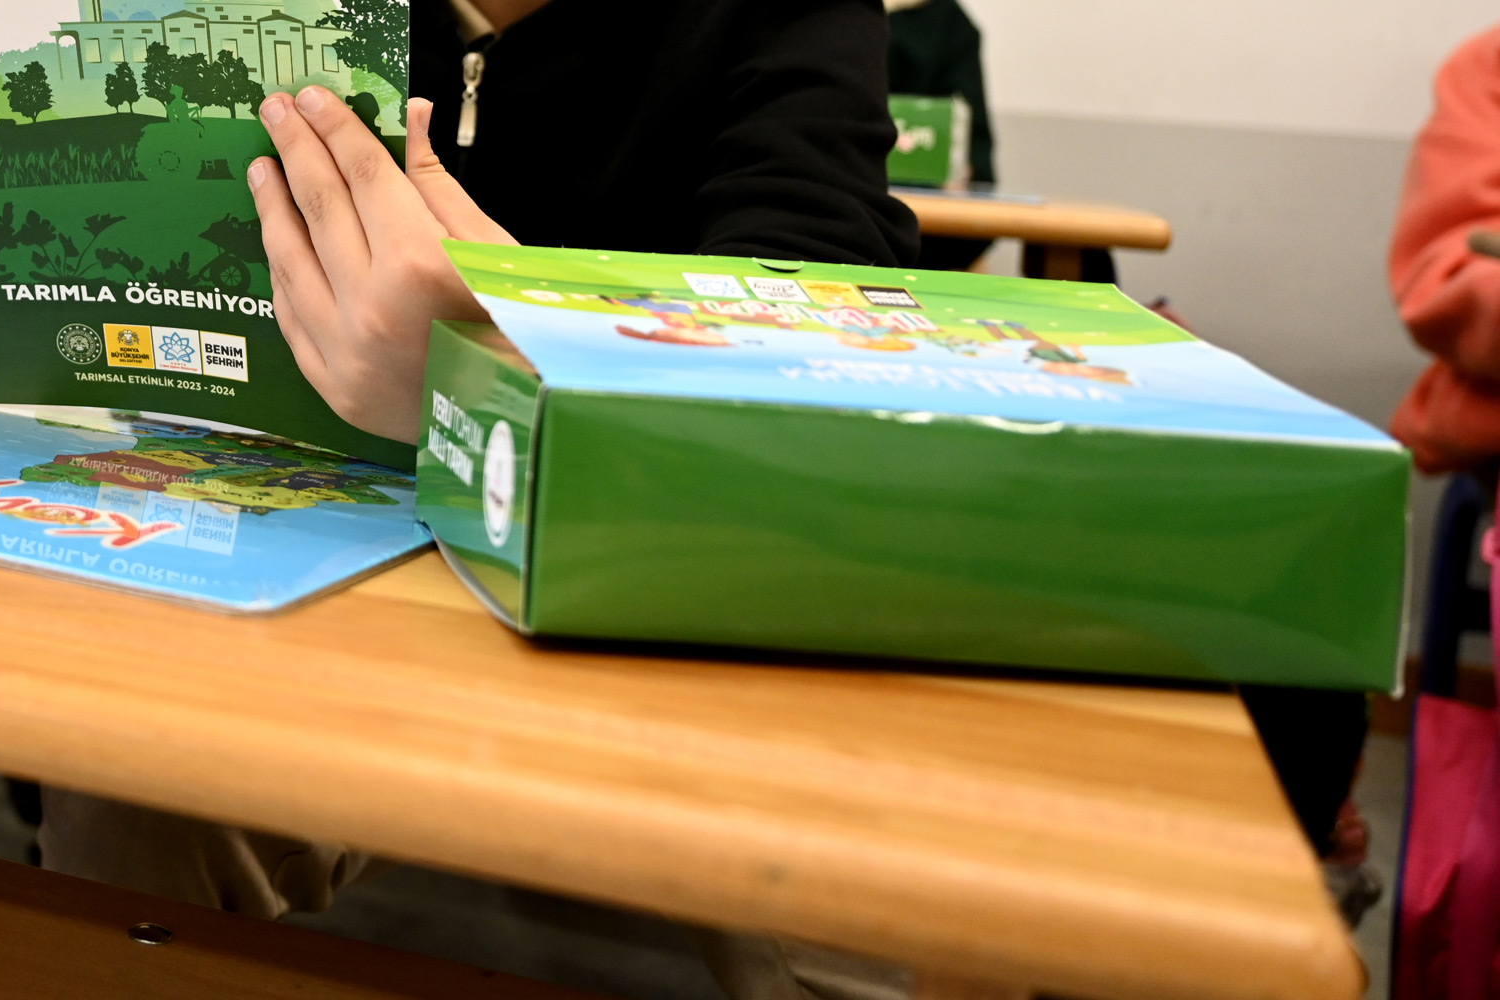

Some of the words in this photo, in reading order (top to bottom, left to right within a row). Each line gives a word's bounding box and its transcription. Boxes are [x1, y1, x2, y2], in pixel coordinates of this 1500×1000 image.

[1, 283, 116, 303] TARIMLA
[205, 342, 243, 358] BENİM
[206, 355, 244, 370] ŞEHRİM
[74, 372, 126, 384] TARIMSAL
[128, 374, 175, 388] ETKİNLİK
[177, 379, 201, 391] 2023
[210, 385, 236, 397] 2024
